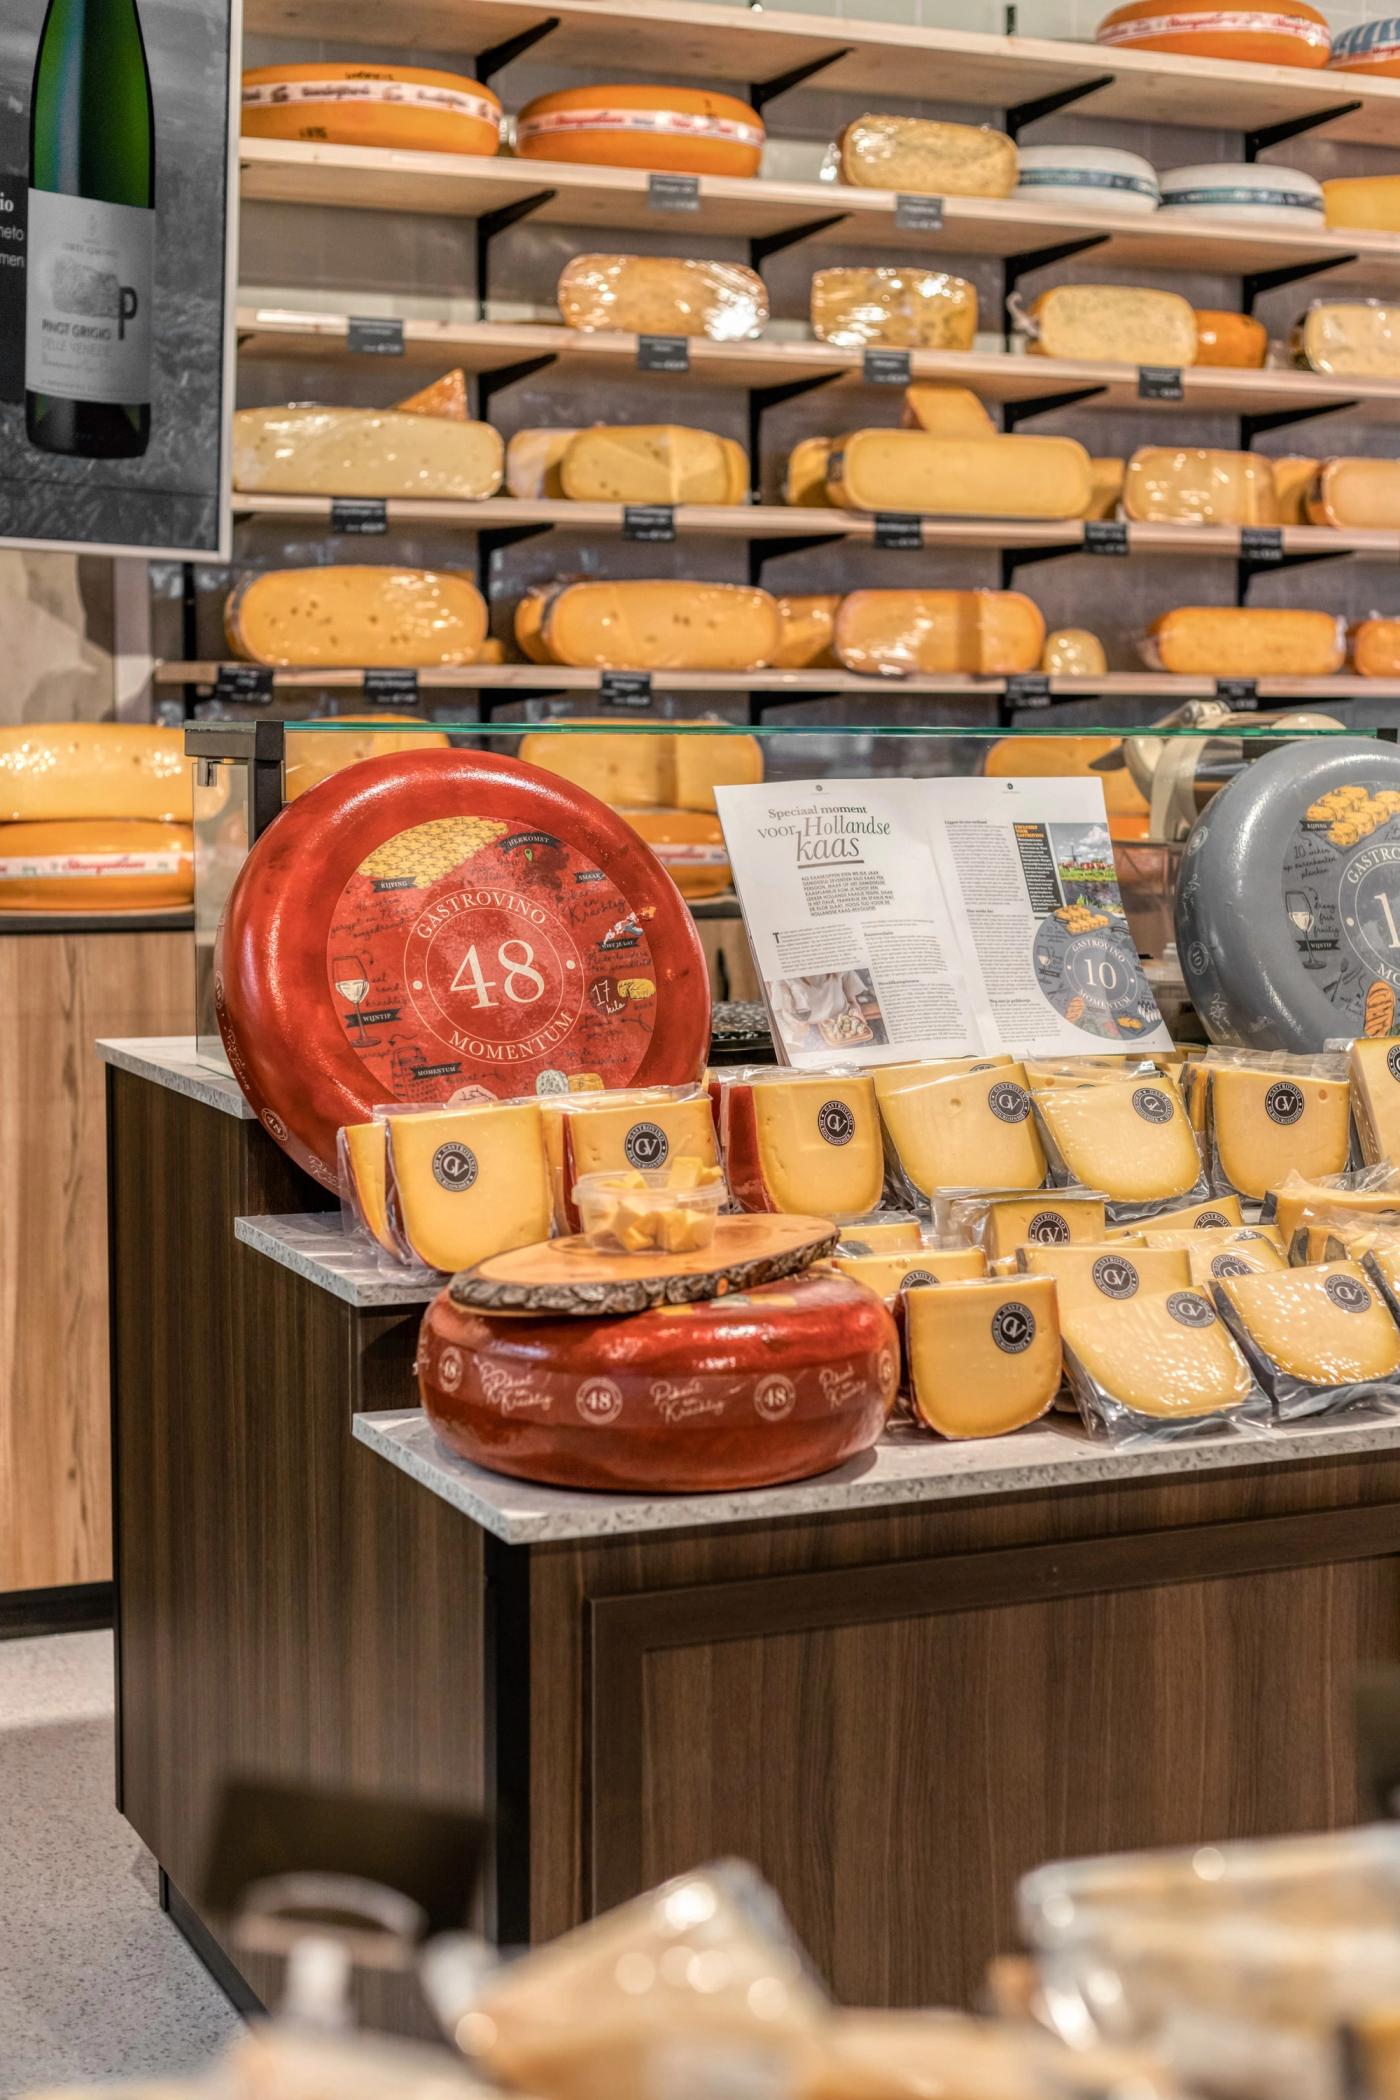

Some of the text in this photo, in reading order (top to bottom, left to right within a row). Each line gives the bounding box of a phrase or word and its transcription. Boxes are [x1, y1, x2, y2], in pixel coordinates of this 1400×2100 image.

[42, 319, 112, 340] PINOT GRIGIO
[768, 805, 868, 821] Speciaal moment
[757, 815, 891, 839] voor Hollandse
[507, 836, 550, 847] HERKOMST
[796, 830, 860, 862] kaas
[1294, 845, 1306, 859] 10
[380, 881, 408, 889] RIJPING
[578, 873, 602, 881] SMAAK
[417, 891, 547, 940] GASTROVINO
[1072, 939, 1125, 962] GASTROVINO
[450, 939, 545, 1009] 48
[1084, 959, 1117, 990] 10
[592, 979, 611, 1006] 17
[1080, 988, 1130, 1009] MOMENTUM
[362, 1013, 392, 1022] WIJNTIP
[449, 1011, 574, 1061] MOMENTUM
[417, 1066, 456, 1076] MOMENTUM
[1269, 1084, 1301, 1100] GASTROVINO
[999, 1094, 1020, 1110] GV
[1275, 1095, 1295, 1111] GV
[266, 1117, 282, 1134] 48
[827, 1114, 847, 1132] GV
[630, 1125, 665, 1141] GASTROVINO
[635, 1138, 658, 1156] GV
[443, 1156, 469, 1177] GV
[1031, 1214, 1066, 1230] GASTROVINO
[1039, 1227, 1059, 1243] GV
[1103, 1269, 1127, 1285] GV
[1336, 1286, 1359, 1300] GV
[1179, 1303, 1203, 1317] GV
[1002, 1316, 1027, 1338] GV
[587, 1391, 611, 1410] 48
[764, 1388, 786, 1407] 48
